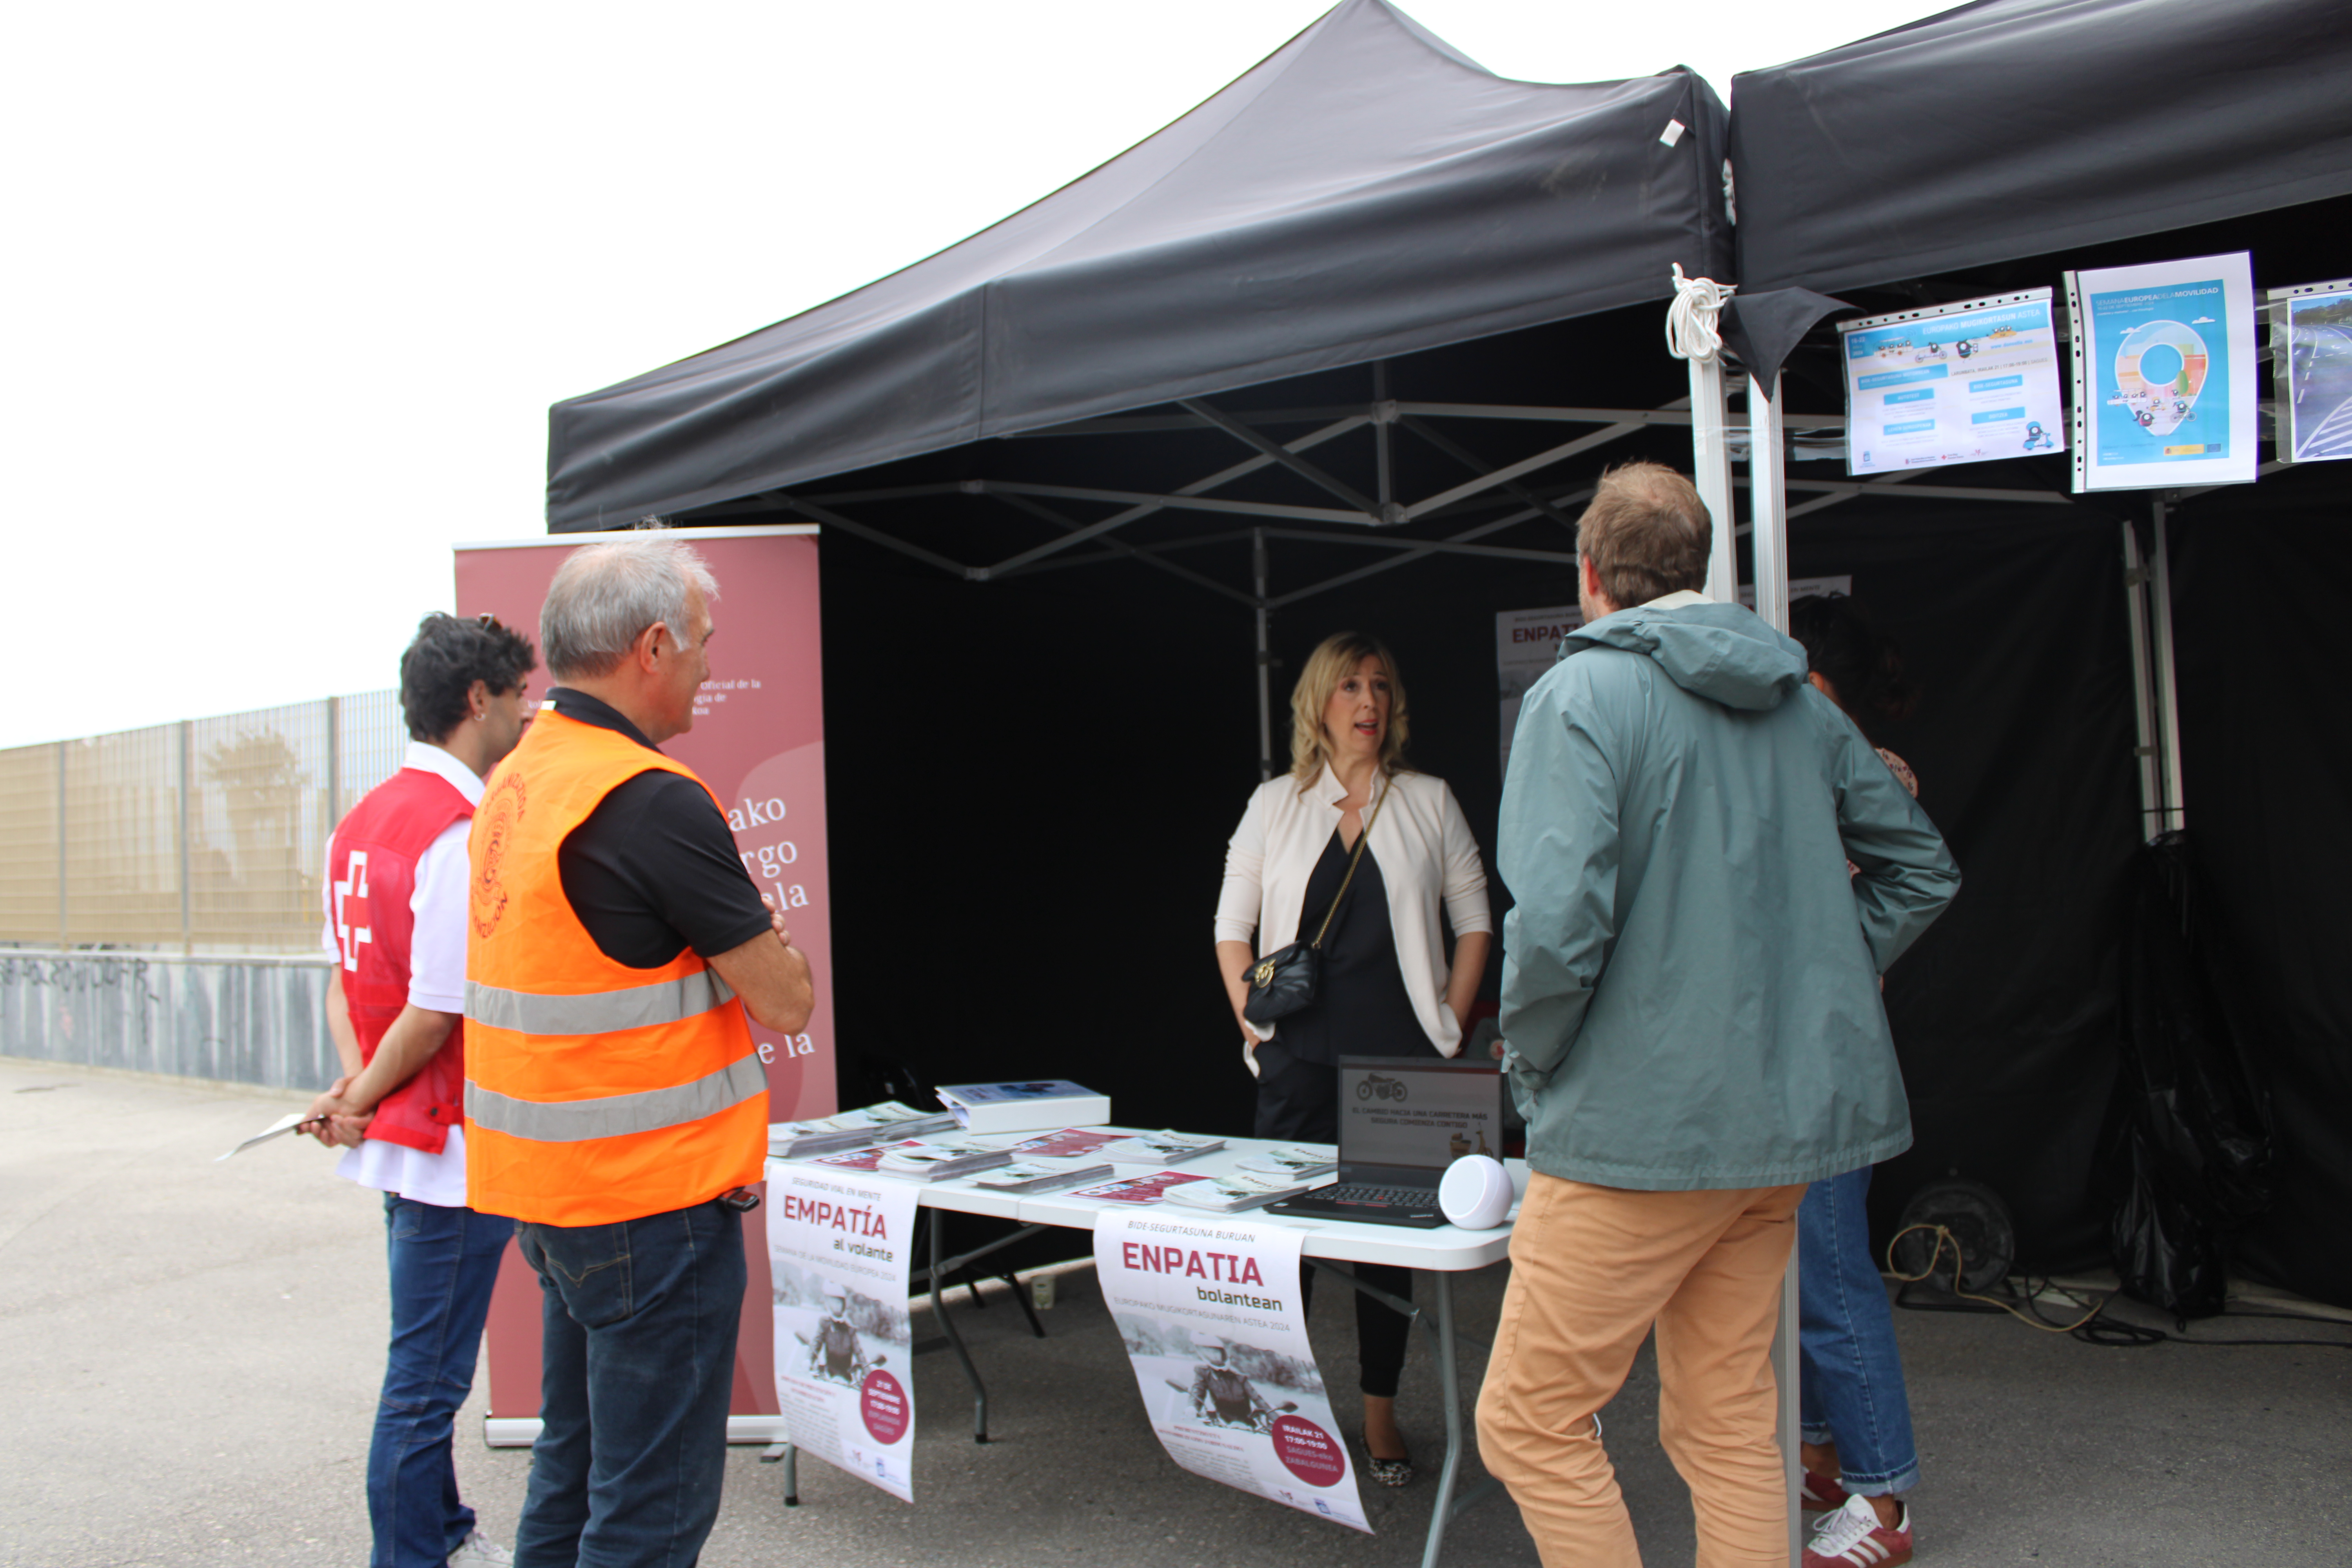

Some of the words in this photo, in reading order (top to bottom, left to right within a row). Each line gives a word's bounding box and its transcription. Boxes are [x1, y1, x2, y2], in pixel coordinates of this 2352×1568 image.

[1923, 322, 1958, 334] EUROPAKO
[1960, 313, 2016, 328] MUGIKORTASUN
[2018, 309, 2040, 319] ASTEA
[1973, 379, 2018, 389] BIDE-SEGURTASUNA
[1512, 622, 1585, 643] ENPAT
[701, 679, 735, 690] Oficial
[736, 679, 749, 689] de
[751, 678, 762, 689] la
[714, 692, 727, 702] de
[728, 797, 786, 833] ako
[739, 841, 798, 878] rgo
[784, 1032, 815, 1058] la
[1429, 1110, 1470, 1119] CARRETERA
[1472, 1112, 1488, 1120] MÁS
[791, 1177, 829, 1191] SEGURIDAD
[831, 1184, 844, 1194] VIAL
[847, 1188, 856, 1196] EN
[858, 1189, 882, 1201] MENTE
[784, 1195, 887, 1240] EMPATÍA
[1127, 1220, 1213, 1238] BIDE-SEGURTASUNA
[1216, 1230, 1255, 1243] BURUAN
[774, 1245, 797, 1256] SEMANA
[850, 1264, 879, 1277] EUROPEA
[833, 1239, 844, 1250] al
[848, 1242, 894, 1262] volante
[1122, 1241, 1264, 1287] ENPATIA
[1197, 1286, 1283, 1312] bolantean
[1114, 1296, 1156, 1310] EUROPAKO
[1157, 1303, 1241, 1325] MUGIKORTASUNAREN
[1243, 1317, 1268, 1328] ASTEA
[1270, 1321, 1290, 1332] 2024
[1282, 1425, 1314, 1437] IRAILAK
[1314, 1432, 1324, 1440] 21
